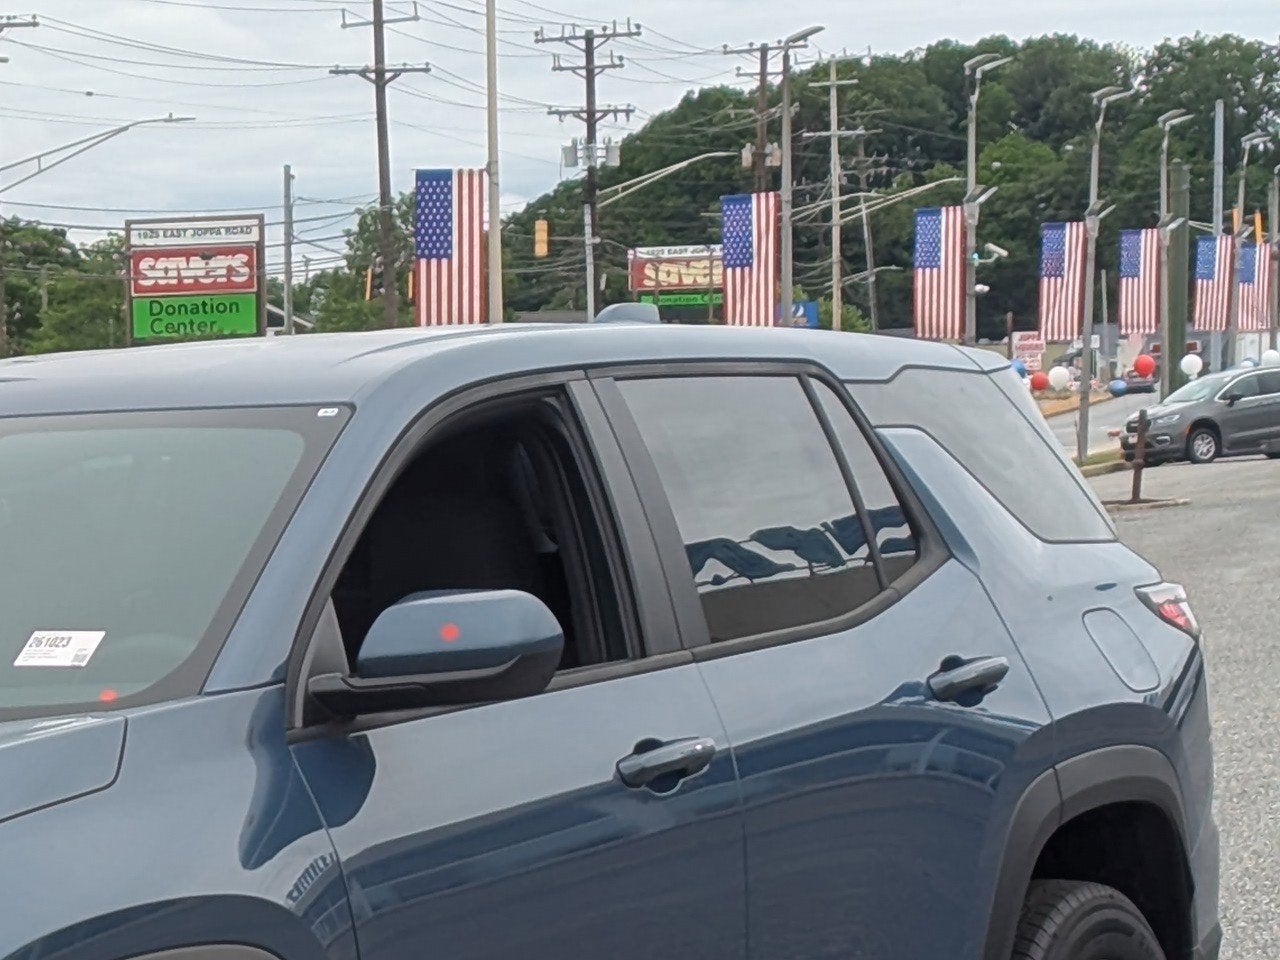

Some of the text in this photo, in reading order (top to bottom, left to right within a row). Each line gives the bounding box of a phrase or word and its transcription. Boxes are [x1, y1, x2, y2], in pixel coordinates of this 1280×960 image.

[162, 227, 188, 238] EAST
[190, 226, 222, 237] JOPPA
[224, 224, 253, 235] ROAD
[137, 253, 251, 287] savers
[148, 298, 240, 317] Donation
[150, 317, 219, 336] Center
